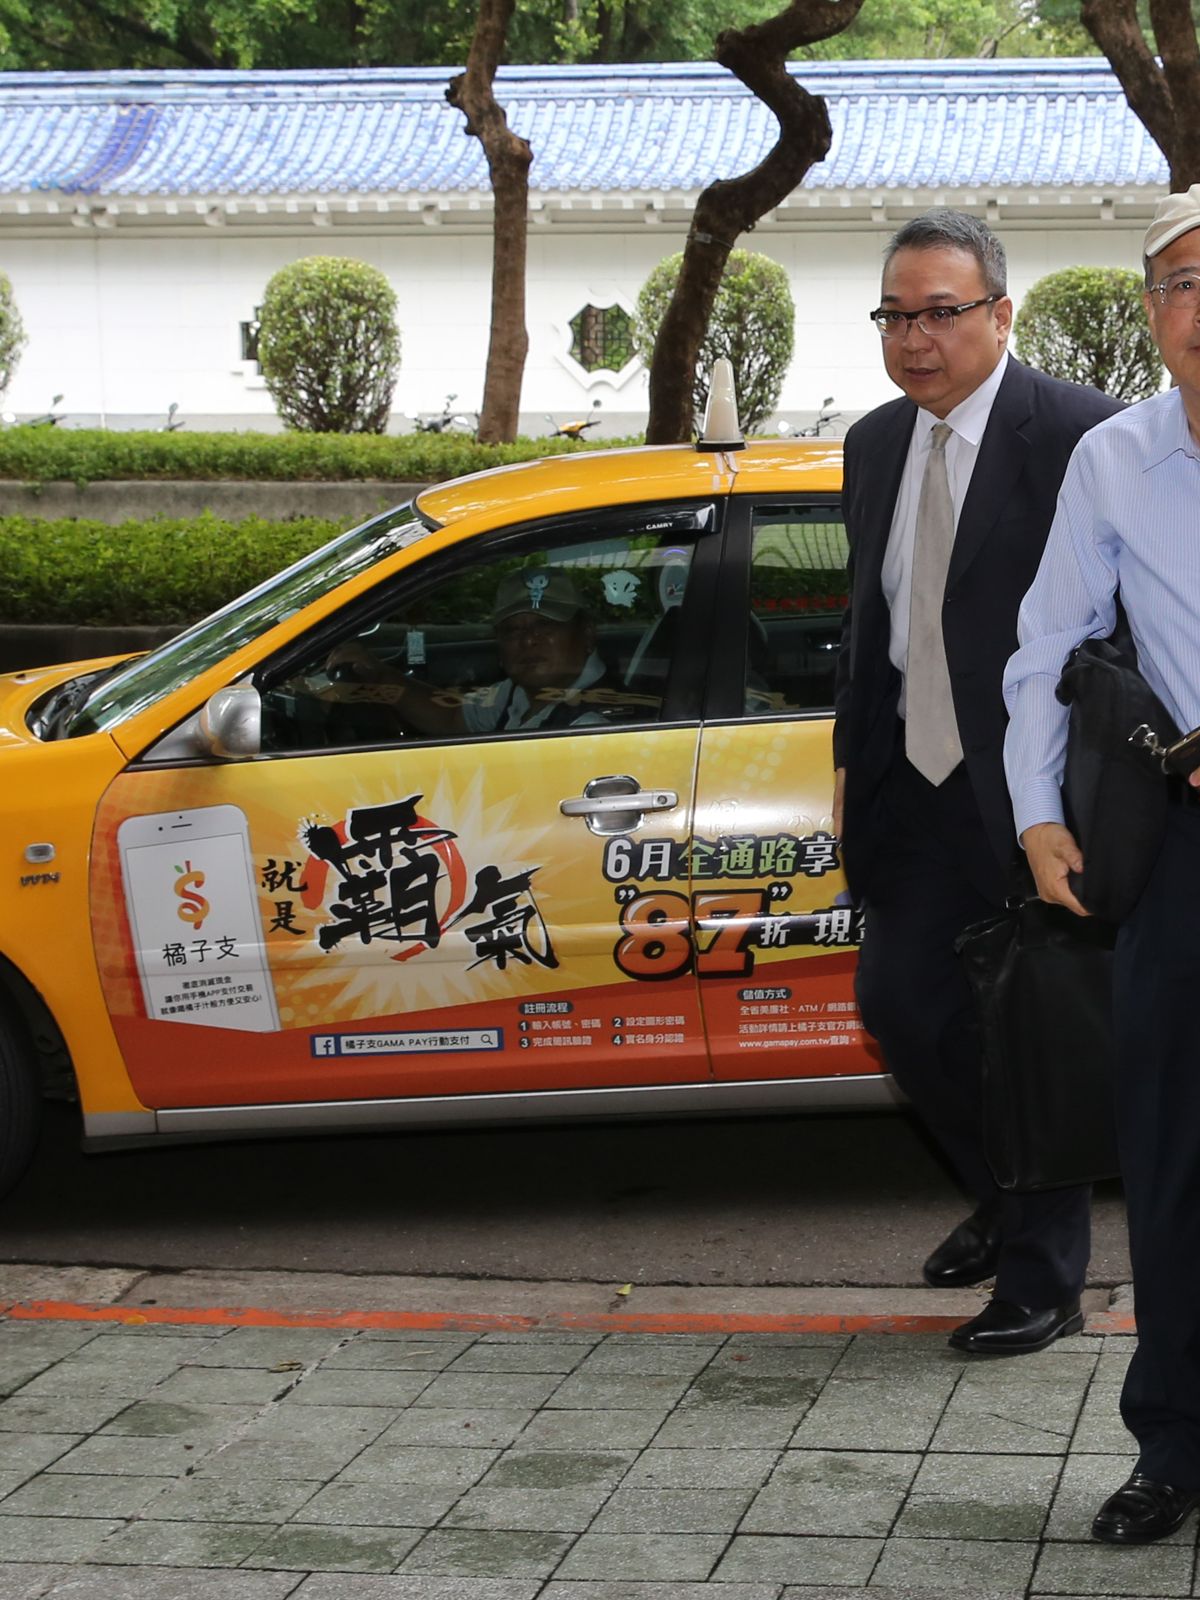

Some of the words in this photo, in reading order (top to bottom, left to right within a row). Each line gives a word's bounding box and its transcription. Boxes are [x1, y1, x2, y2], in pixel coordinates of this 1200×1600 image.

[646, 522, 673, 530] CAMRY
[605, 834, 838, 880] 6月全通路享
[262, 860, 309, 935] 就是
[814, 908, 866, 944] 現
[162, 936, 239, 967] 橘子支
[743, 989, 787, 1000] 儲值方式
[524, 1002, 569, 1014] 註冊流程
[408, 1036, 470, 1047] PAY行動支付
